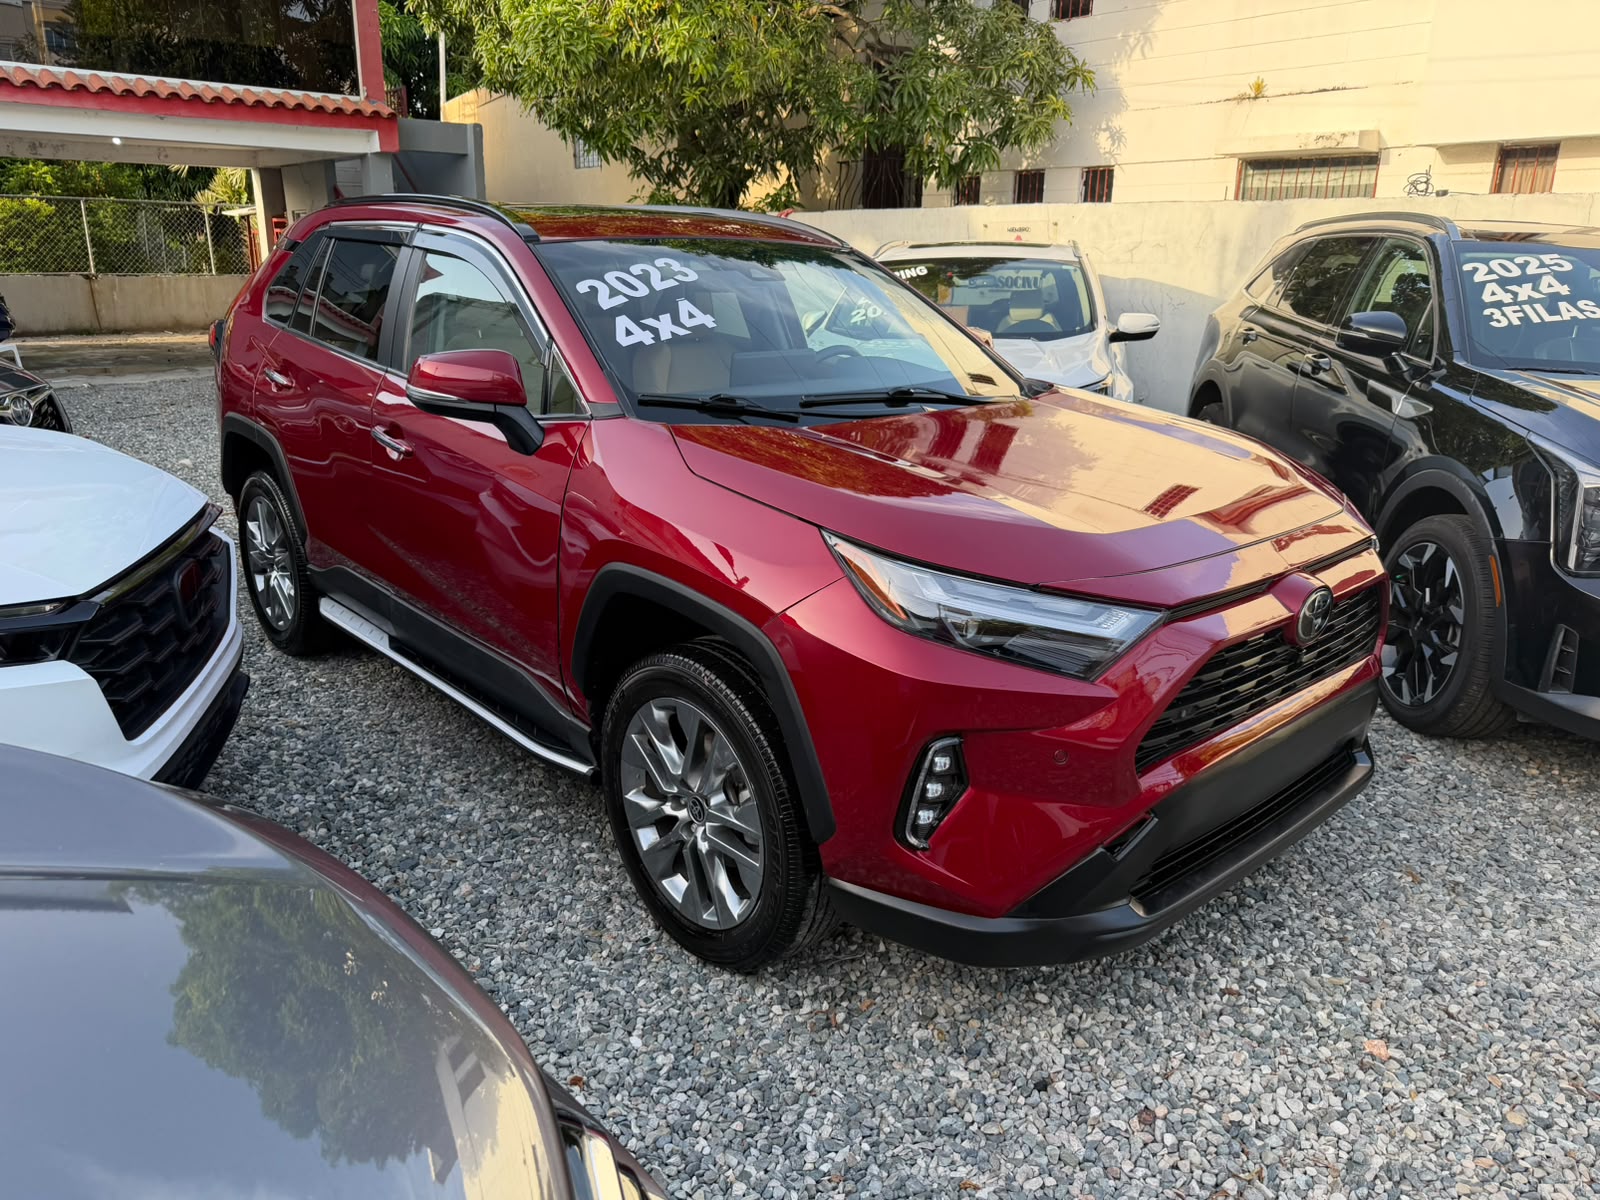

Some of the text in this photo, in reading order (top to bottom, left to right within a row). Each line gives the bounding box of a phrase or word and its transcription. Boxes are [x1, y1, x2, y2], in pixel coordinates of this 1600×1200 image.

[1462, 253, 1573, 283] 2025
[575, 257, 699, 311] 2023
[1481, 274, 1571, 304] 4x4
[615, 297, 718, 347] 4x4
[1482, 299, 1600, 328] 3FILAS
